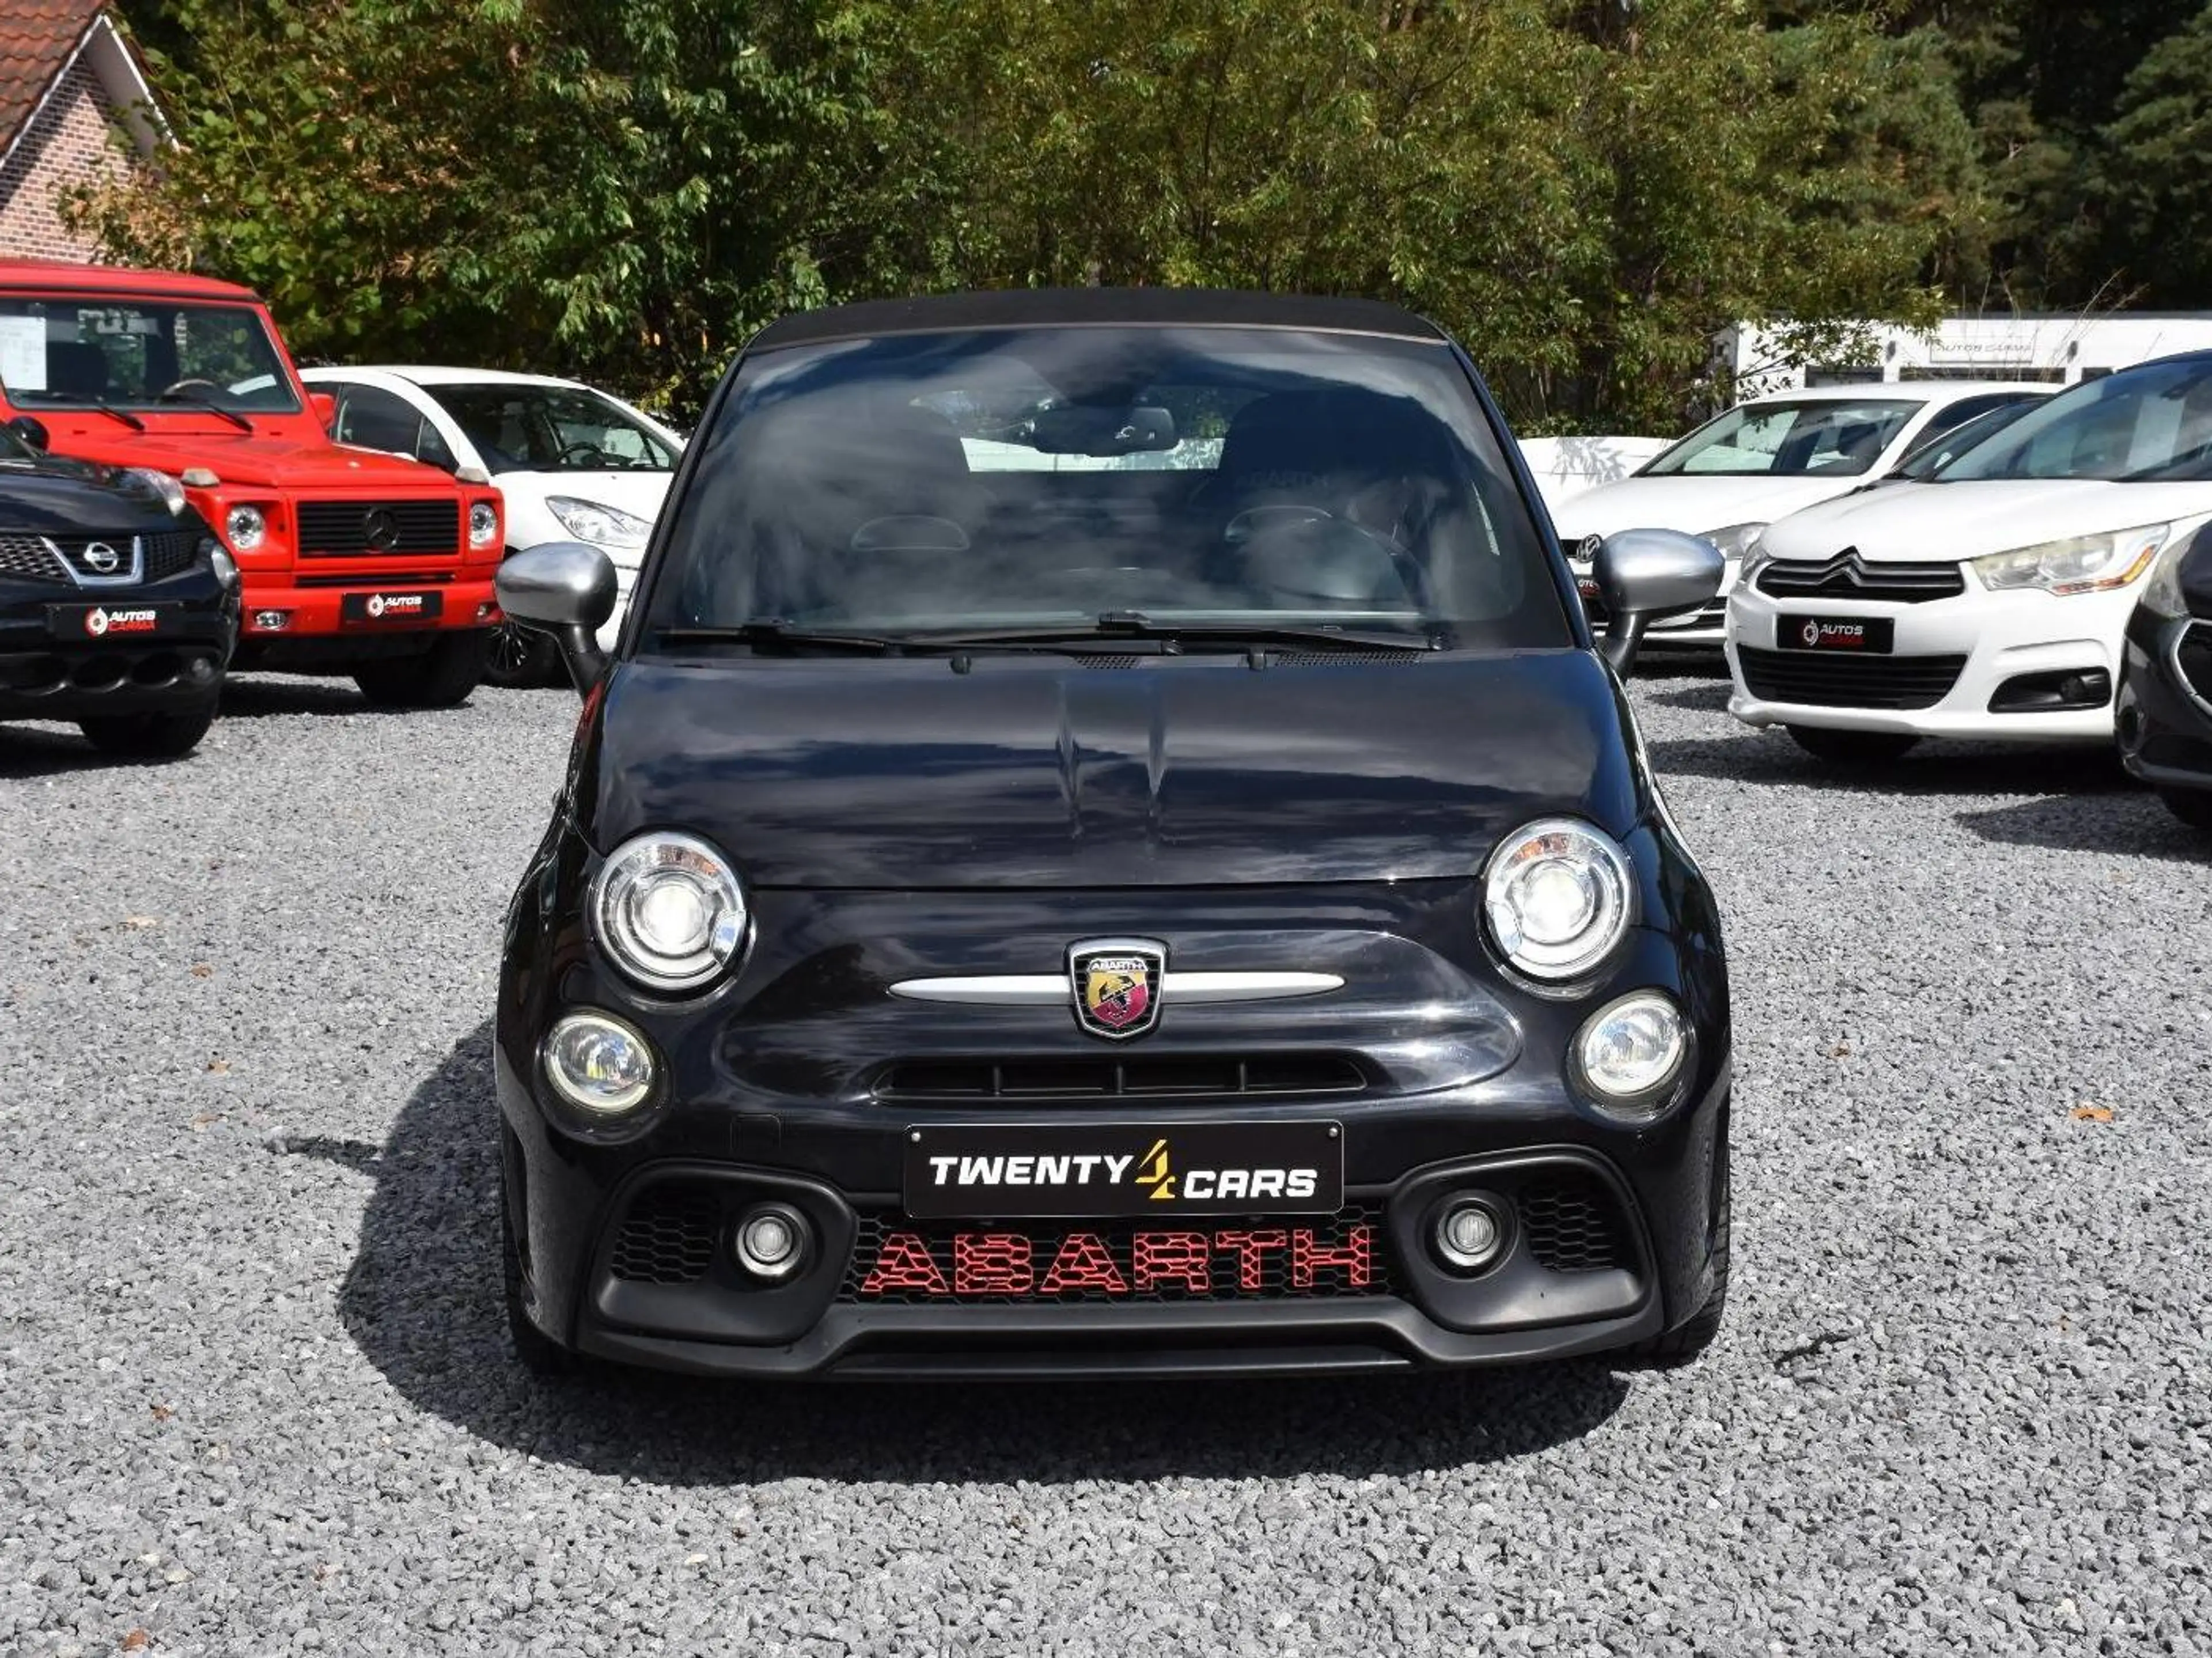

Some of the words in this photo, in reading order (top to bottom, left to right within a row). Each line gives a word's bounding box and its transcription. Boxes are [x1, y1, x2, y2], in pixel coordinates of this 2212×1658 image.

[384, 596, 422, 606] AUTOS
[108, 610, 156, 622] AUTOS
[1819, 624, 1863, 635] AUTOS
[1089, 960, 1145, 970] ABARTH
[929, 1155, 1135, 1185] TWENTY
[1183, 1168, 1318, 1199] CARS
[861, 1227, 1371, 1294] ABARTH
